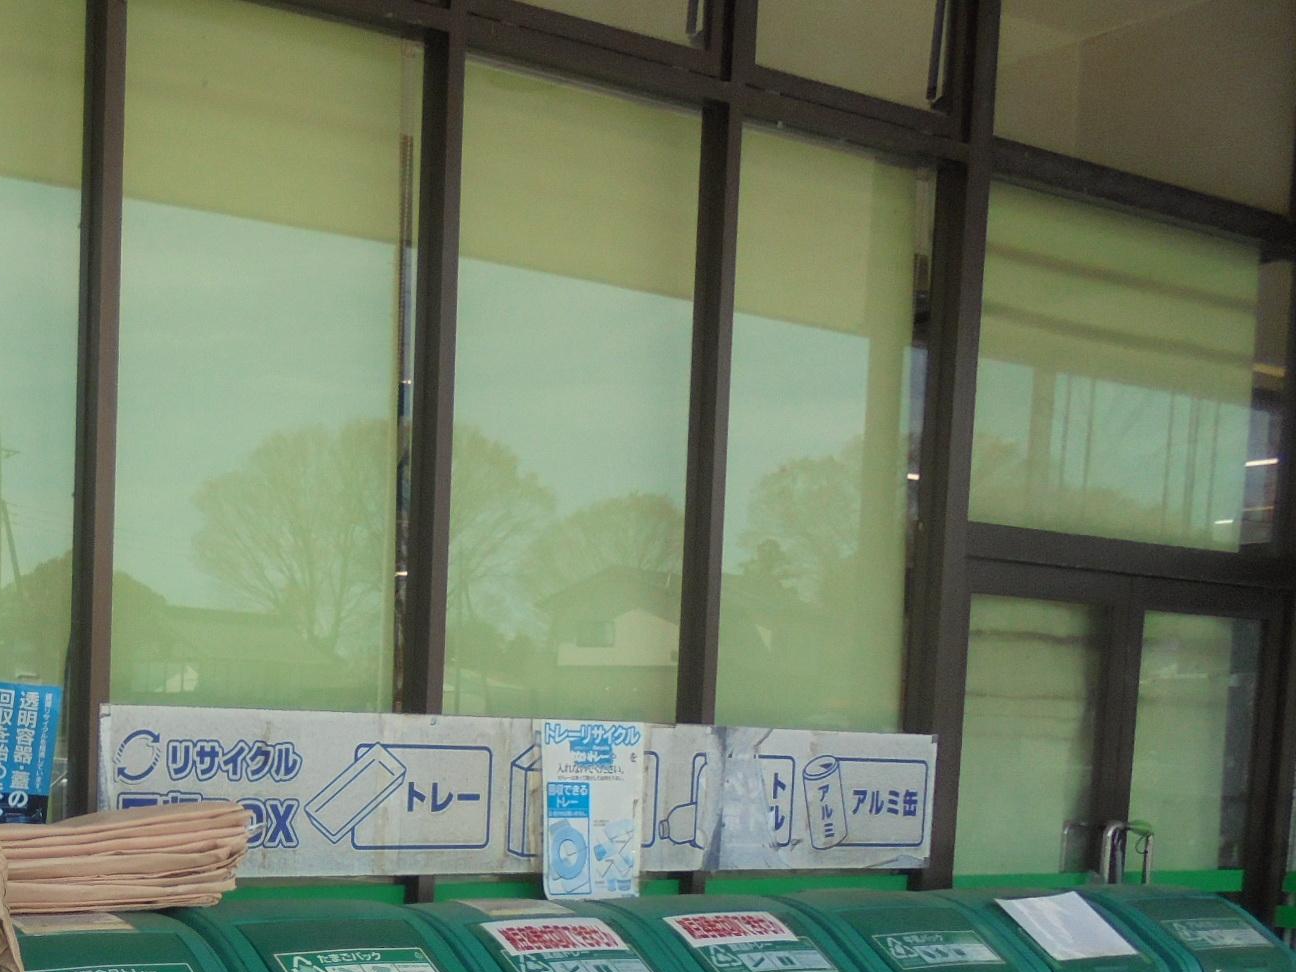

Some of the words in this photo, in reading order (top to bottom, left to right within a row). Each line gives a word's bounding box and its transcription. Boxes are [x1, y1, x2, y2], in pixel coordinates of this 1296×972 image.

[7, 691, 39, 808] 透明容器・蓋の
[544, 722, 641, 746] トレーリサイクル
[166, 739, 303, 782] リサイクル
[407, 782, 481, 812] トレー
[817, 785, 836, 838] アルミ
[852, 788, 918, 818] アルミ缶
